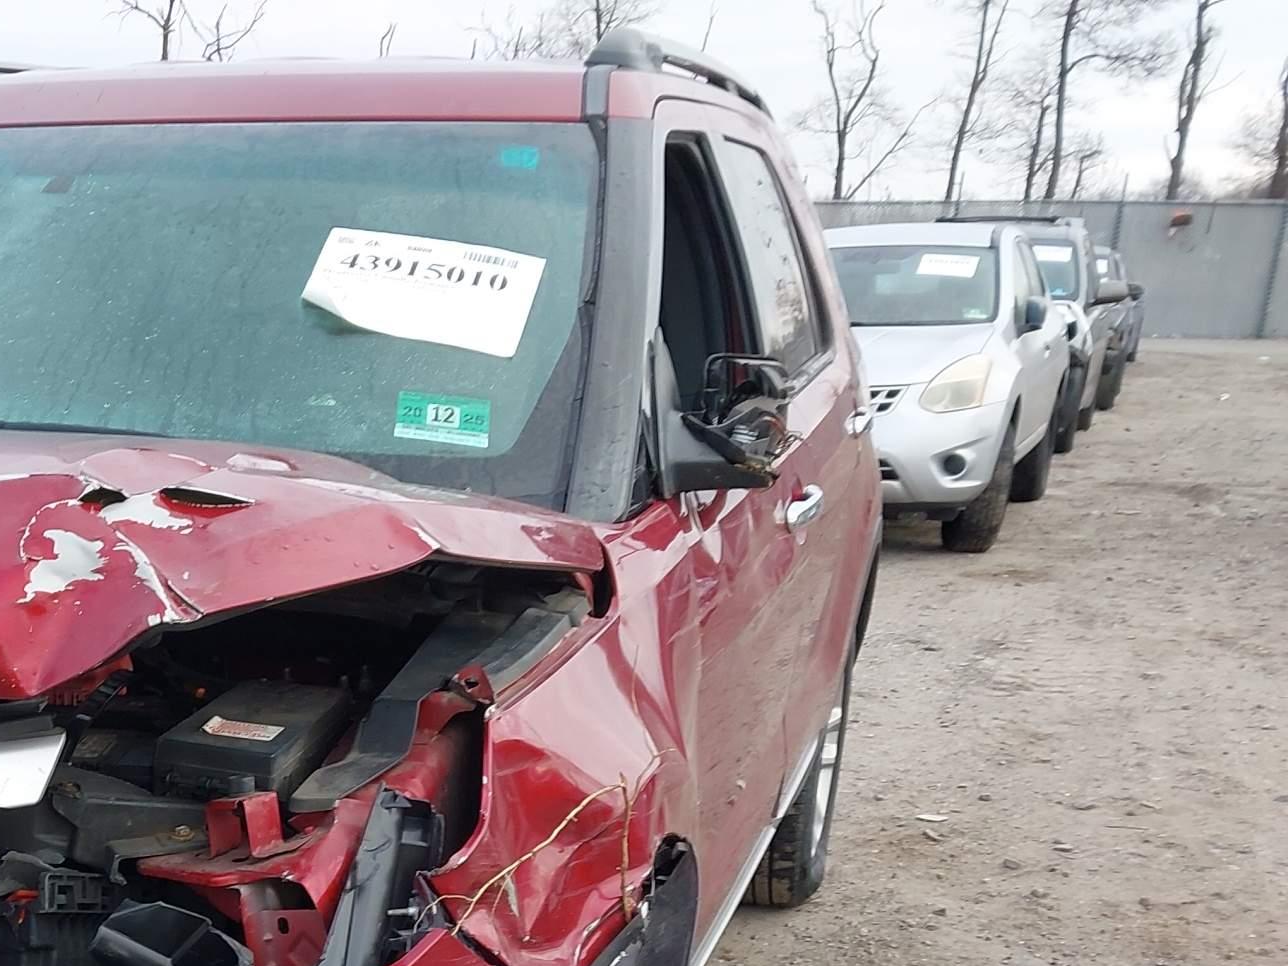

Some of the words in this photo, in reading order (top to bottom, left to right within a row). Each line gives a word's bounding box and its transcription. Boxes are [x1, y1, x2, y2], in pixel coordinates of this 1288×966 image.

[339, 252, 509, 292] 43915010
[402, 405, 424, 418] 20
[431, 405, 455, 424] 12
[463, 413, 486, 426] 25
